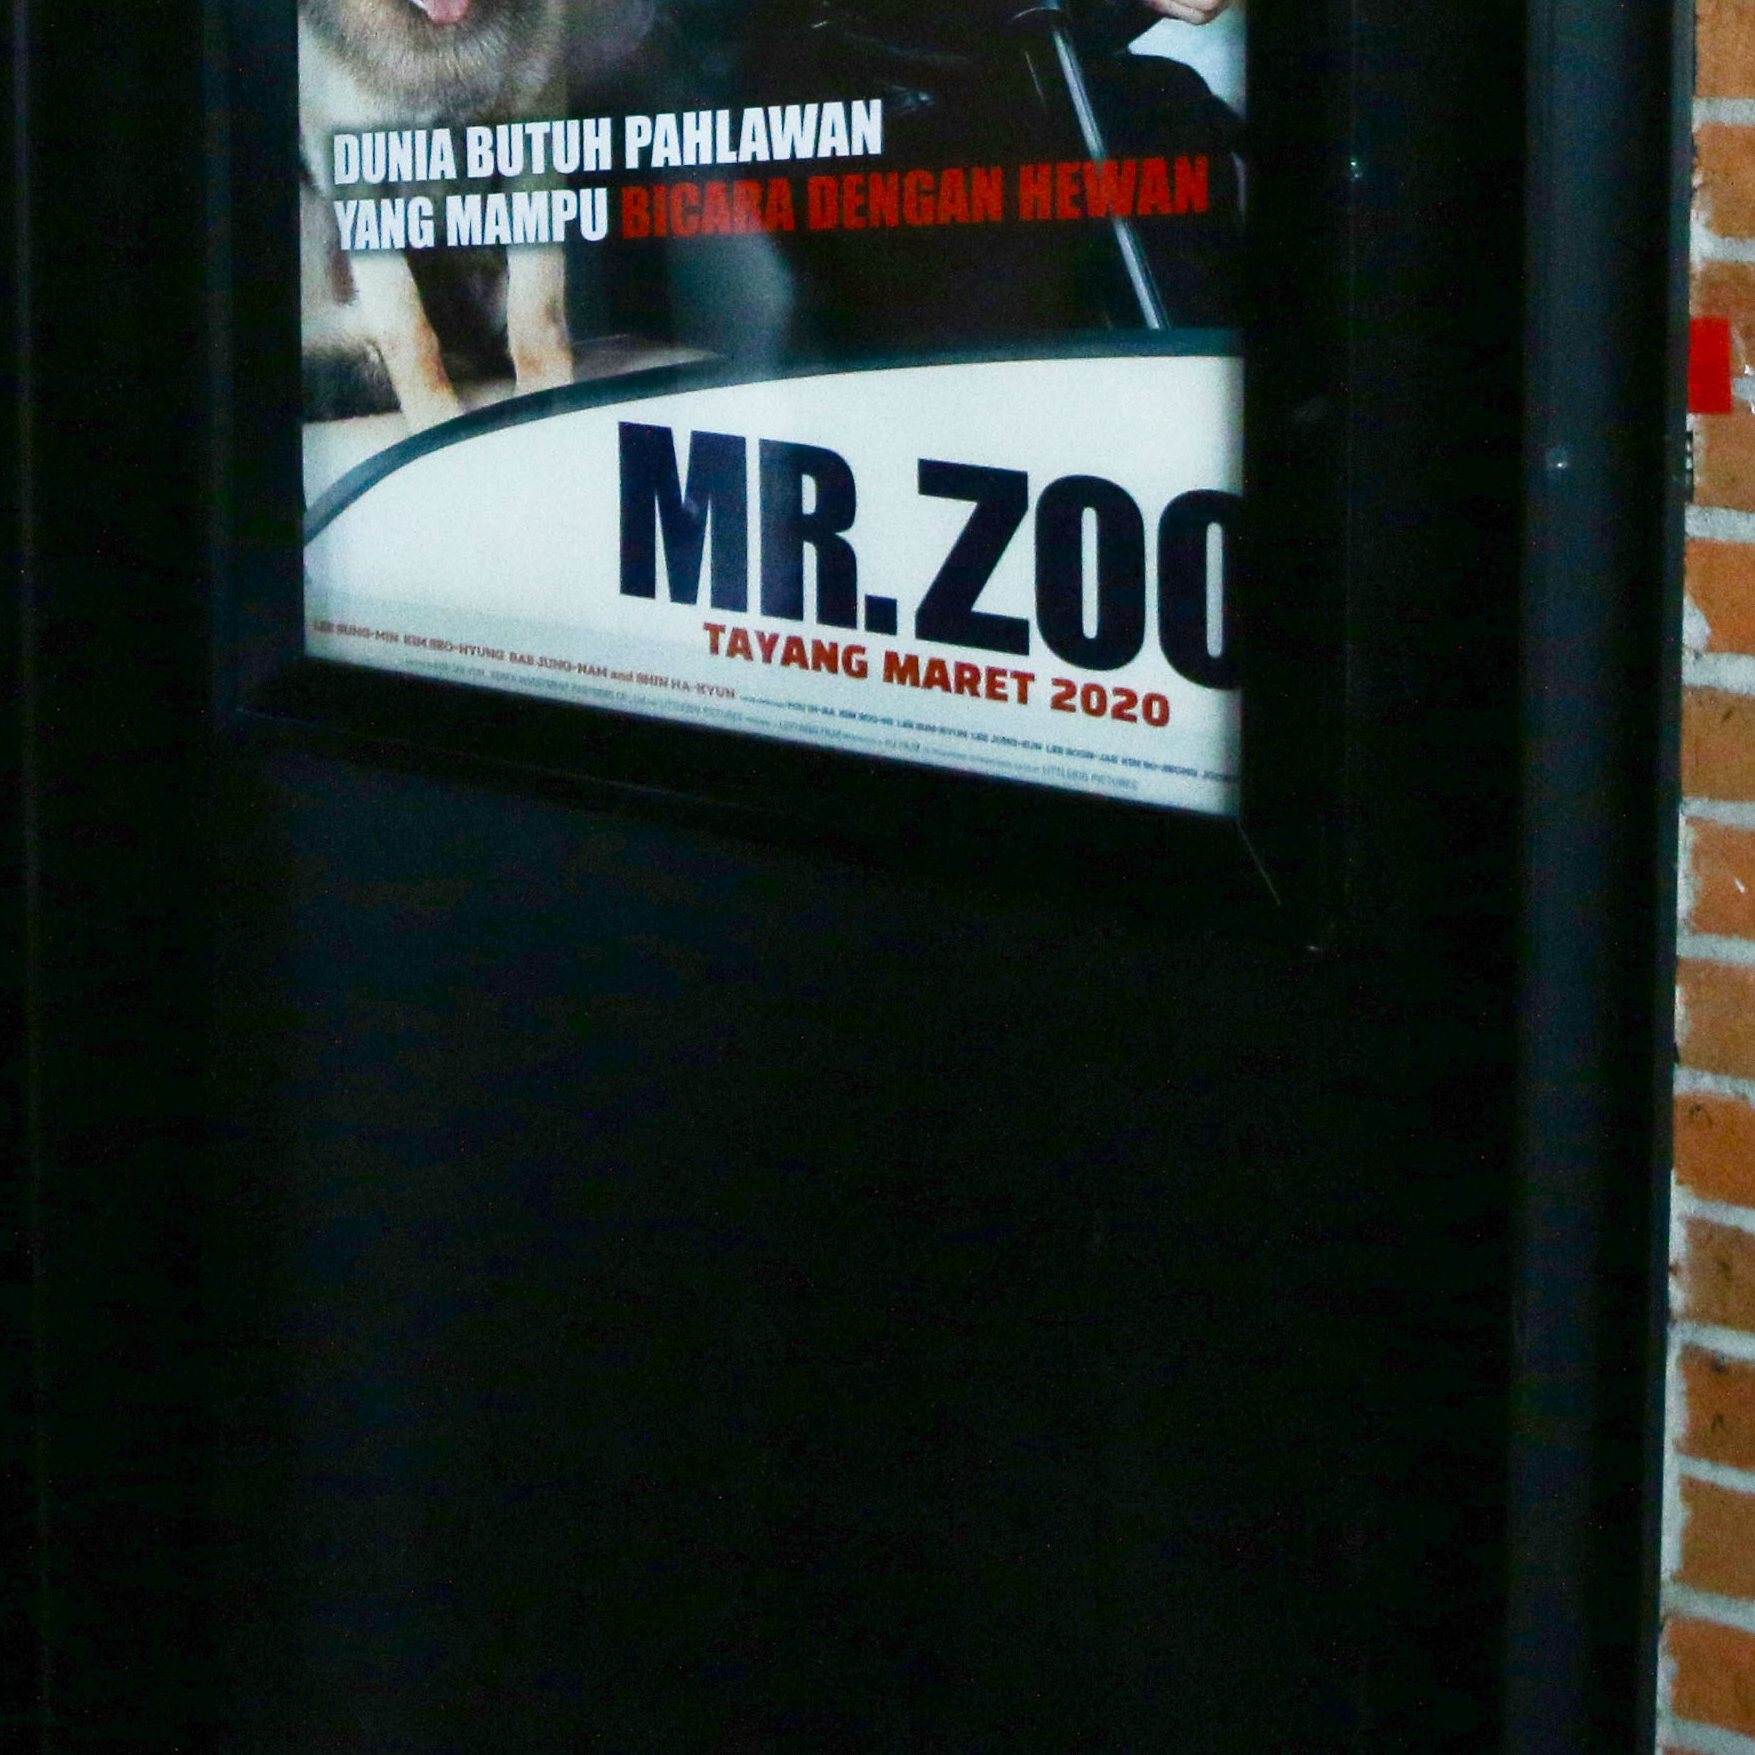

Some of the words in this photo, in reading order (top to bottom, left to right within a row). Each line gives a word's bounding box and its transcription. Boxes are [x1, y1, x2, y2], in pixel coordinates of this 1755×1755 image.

[333, 127, 457, 186] DUNIA
[466, 116, 613, 179] BUTUH
[624, 99, 884, 170] PAHLAWAN
[333, 196, 435, 251] YANG
[446, 187, 609, 247] MAMPU
[621, 177, 796, 241] BICARA
[807, 166, 1004, 231] DENGAN
[1018, 155, 1210, 222] HEWAN
[617, 420, 1243, 692] MR.ZOO
[704, 621, 868, 679] TAYANG
[882, 651, 1035, 706] MARET
[1050, 677, 1171, 728] 2020
